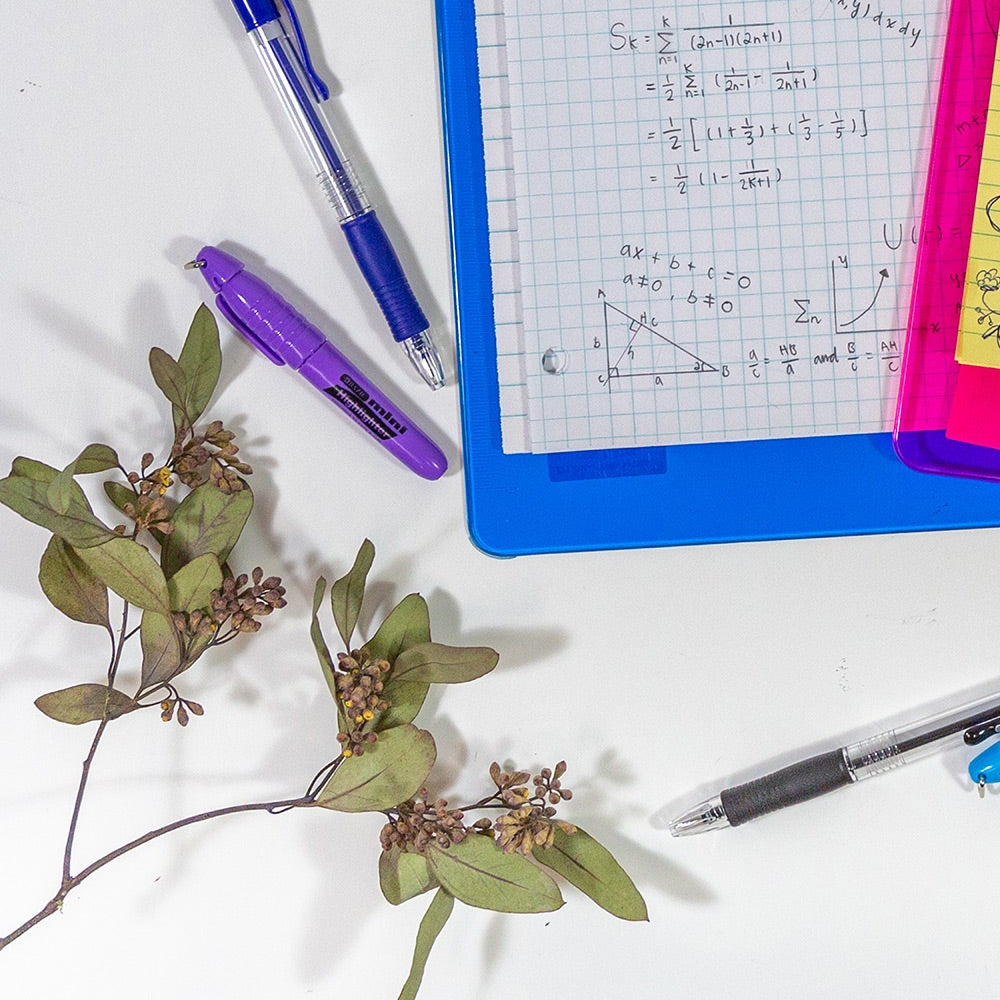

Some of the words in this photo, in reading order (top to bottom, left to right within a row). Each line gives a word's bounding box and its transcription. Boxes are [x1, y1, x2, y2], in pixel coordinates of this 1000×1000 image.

[813, 346, 840, 365] and
[335, 388, 388, 438] Highlighter
[367, 399, 409, 435] mini
